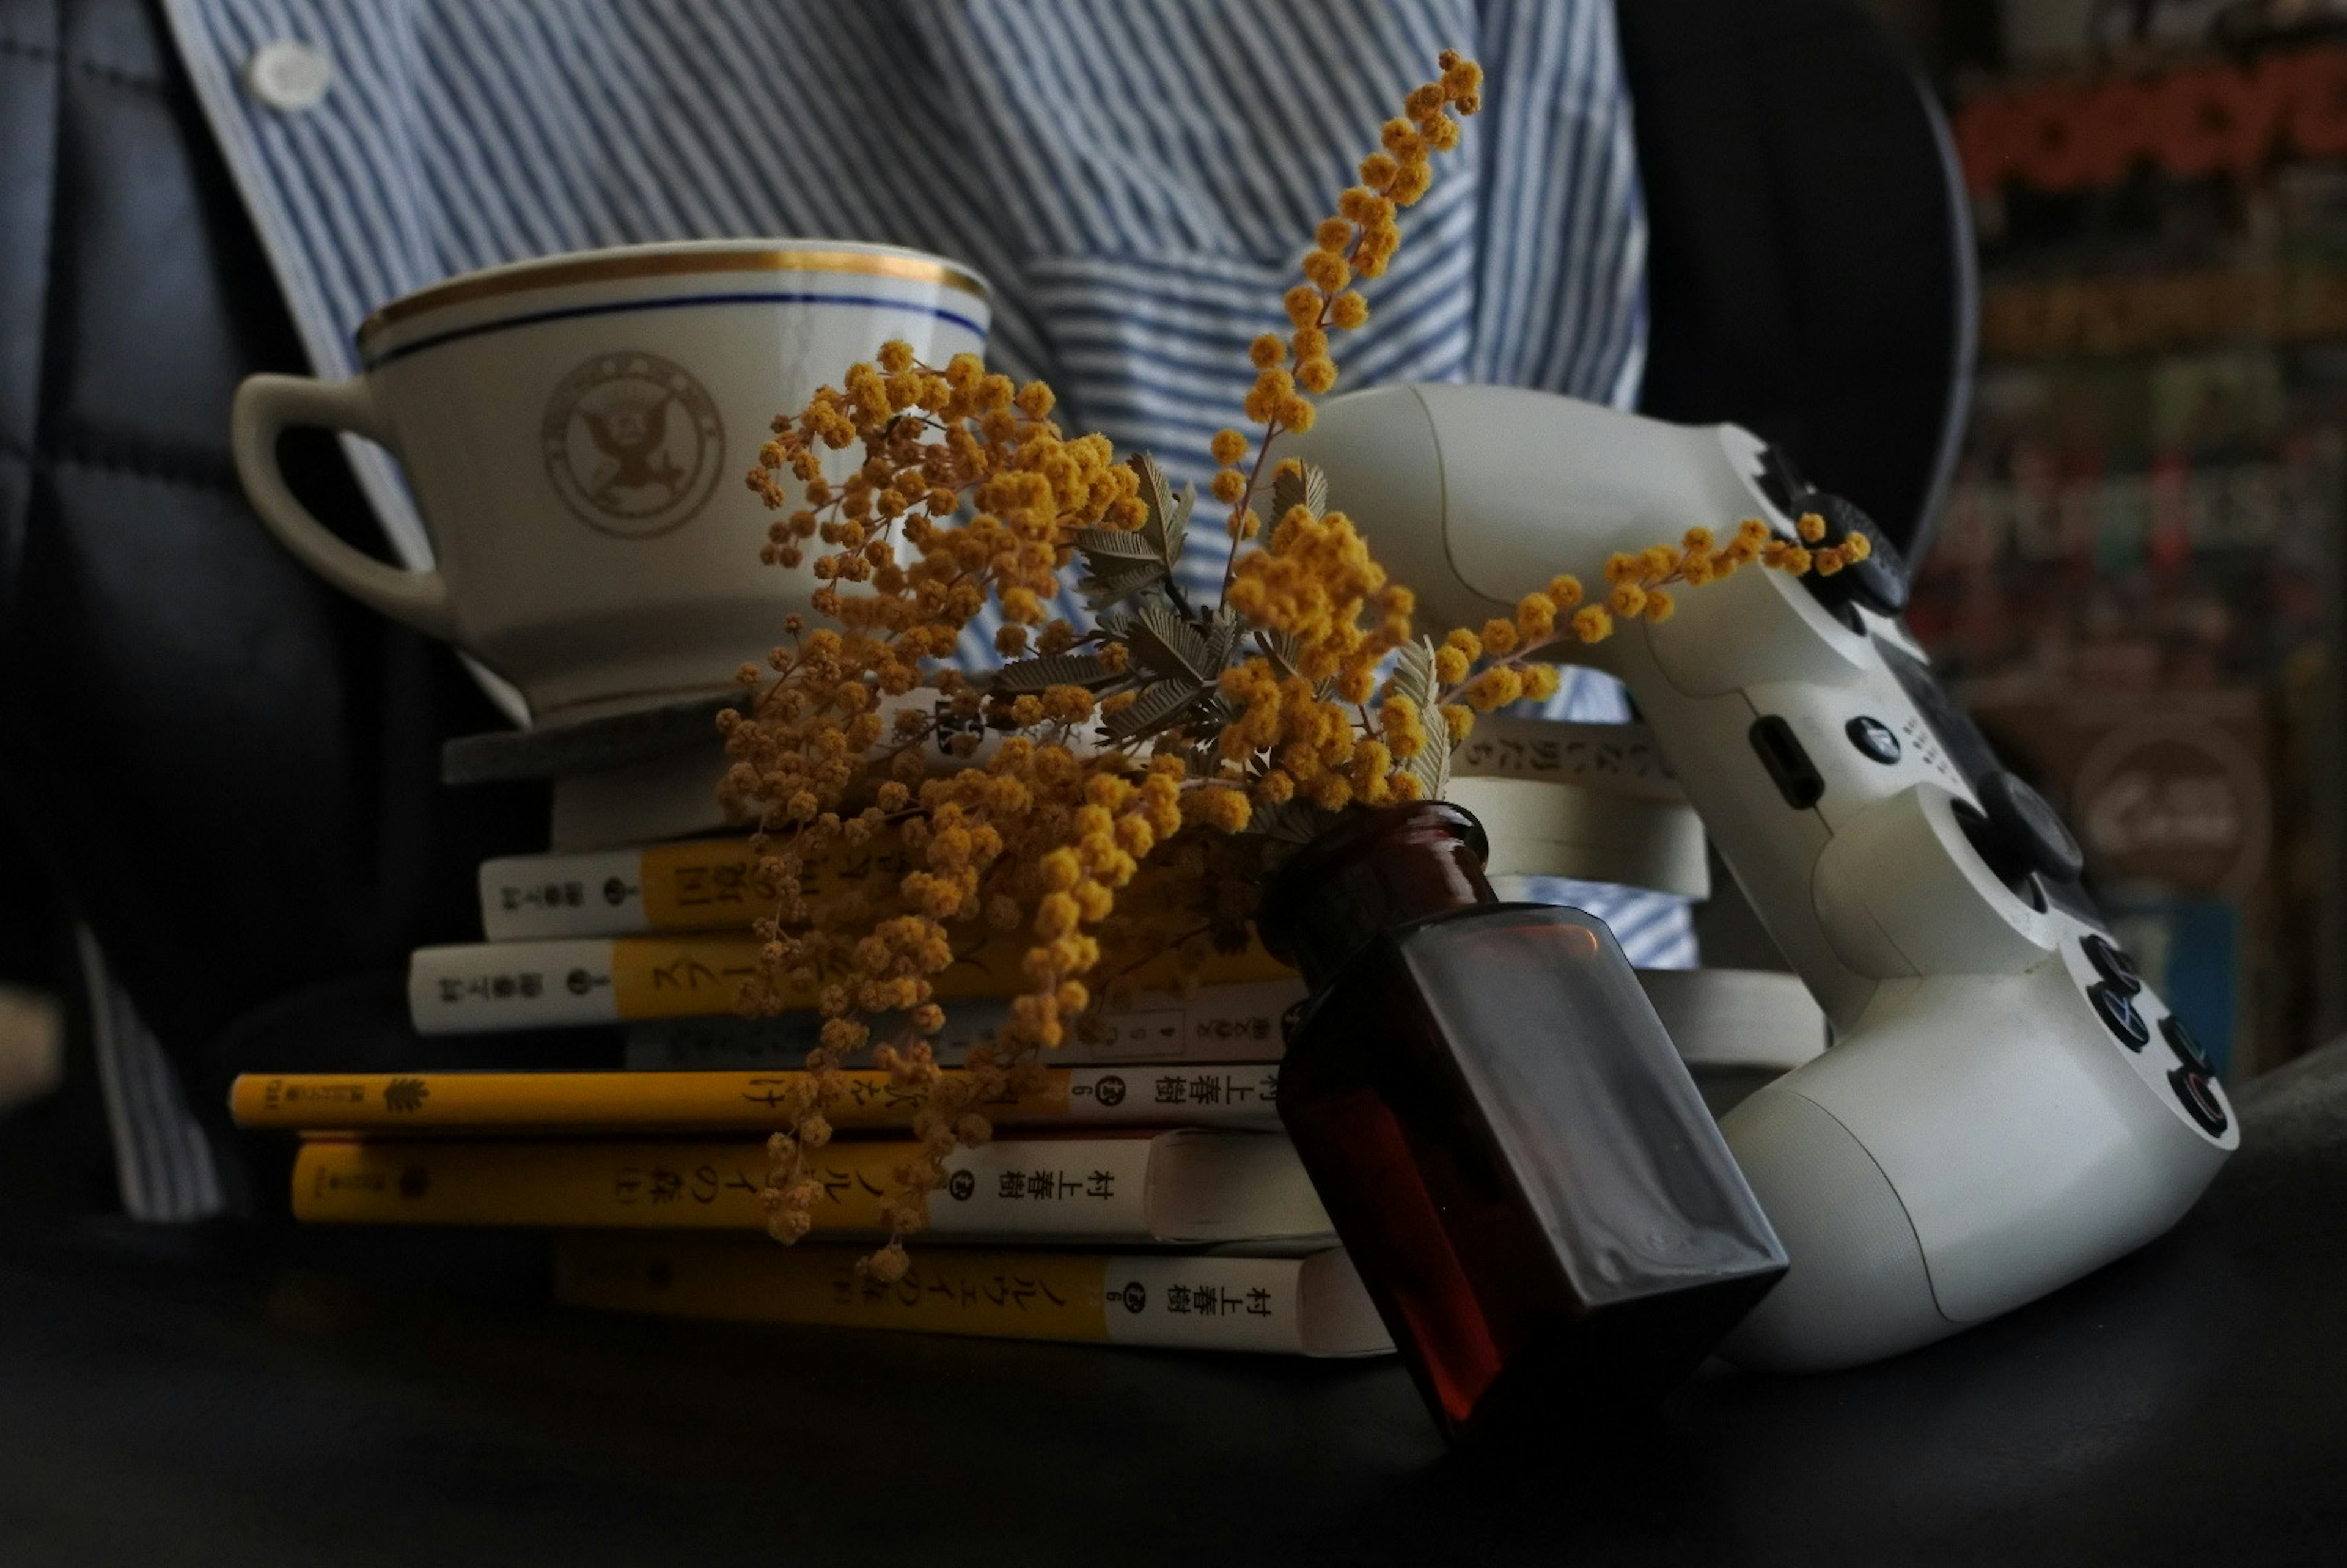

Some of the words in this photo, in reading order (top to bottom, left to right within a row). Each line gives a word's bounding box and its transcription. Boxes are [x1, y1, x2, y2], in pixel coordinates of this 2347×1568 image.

[1468, 737, 1673, 779] いない男たち
[1154, 1074, 1280, 1106] 村上春樹
[997, 1170, 1115, 1198] 村上春樹
[1167, 1284, 1272, 1319] 村上春樹
